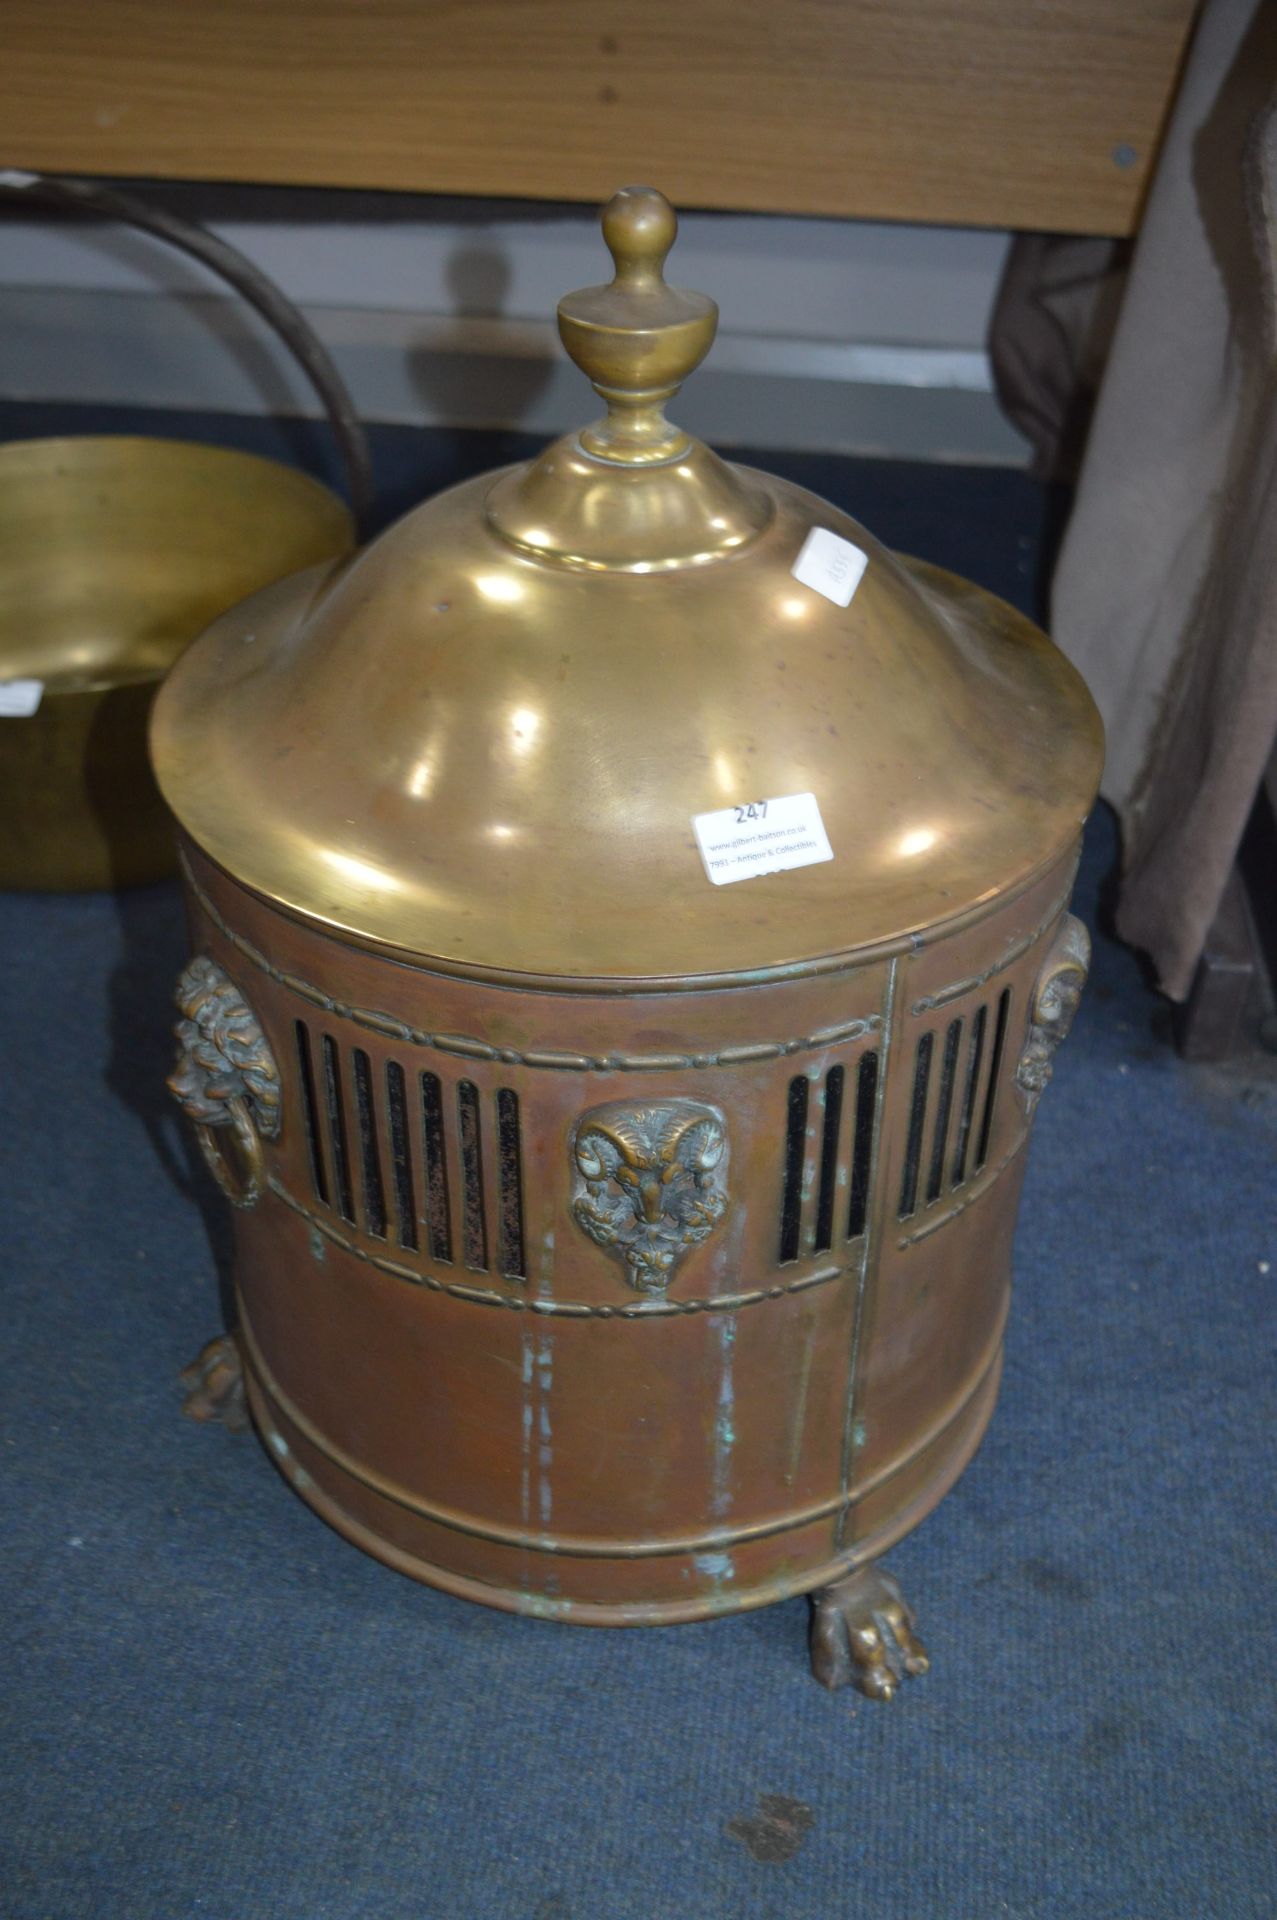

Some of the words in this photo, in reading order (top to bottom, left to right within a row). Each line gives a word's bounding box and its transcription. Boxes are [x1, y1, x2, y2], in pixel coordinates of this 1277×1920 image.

[734, 801, 768, 823] 247
[737, 850, 767, 863] Antique
[768, 850, 775, 858] &
